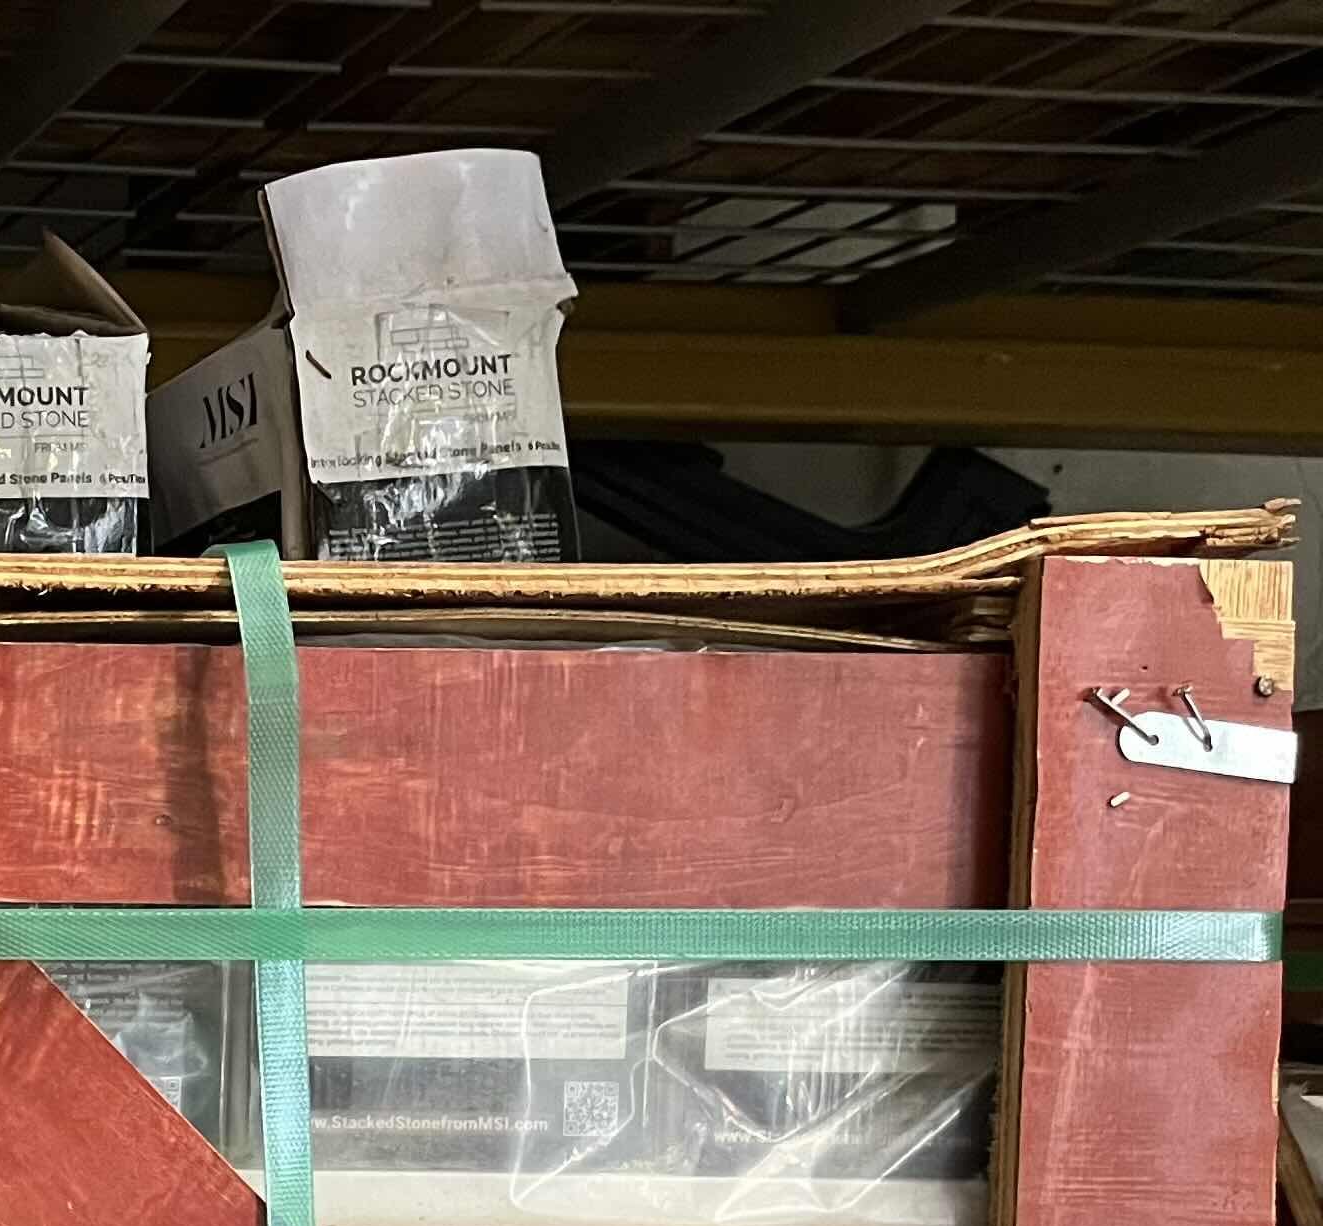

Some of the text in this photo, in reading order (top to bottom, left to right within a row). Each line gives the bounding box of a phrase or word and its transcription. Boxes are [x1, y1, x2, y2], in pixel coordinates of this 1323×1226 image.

[353, 379, 515, 408] STACKED STONE
[21, 410, 89, 428] STONE
[200, 372, 258, 448] MSI
